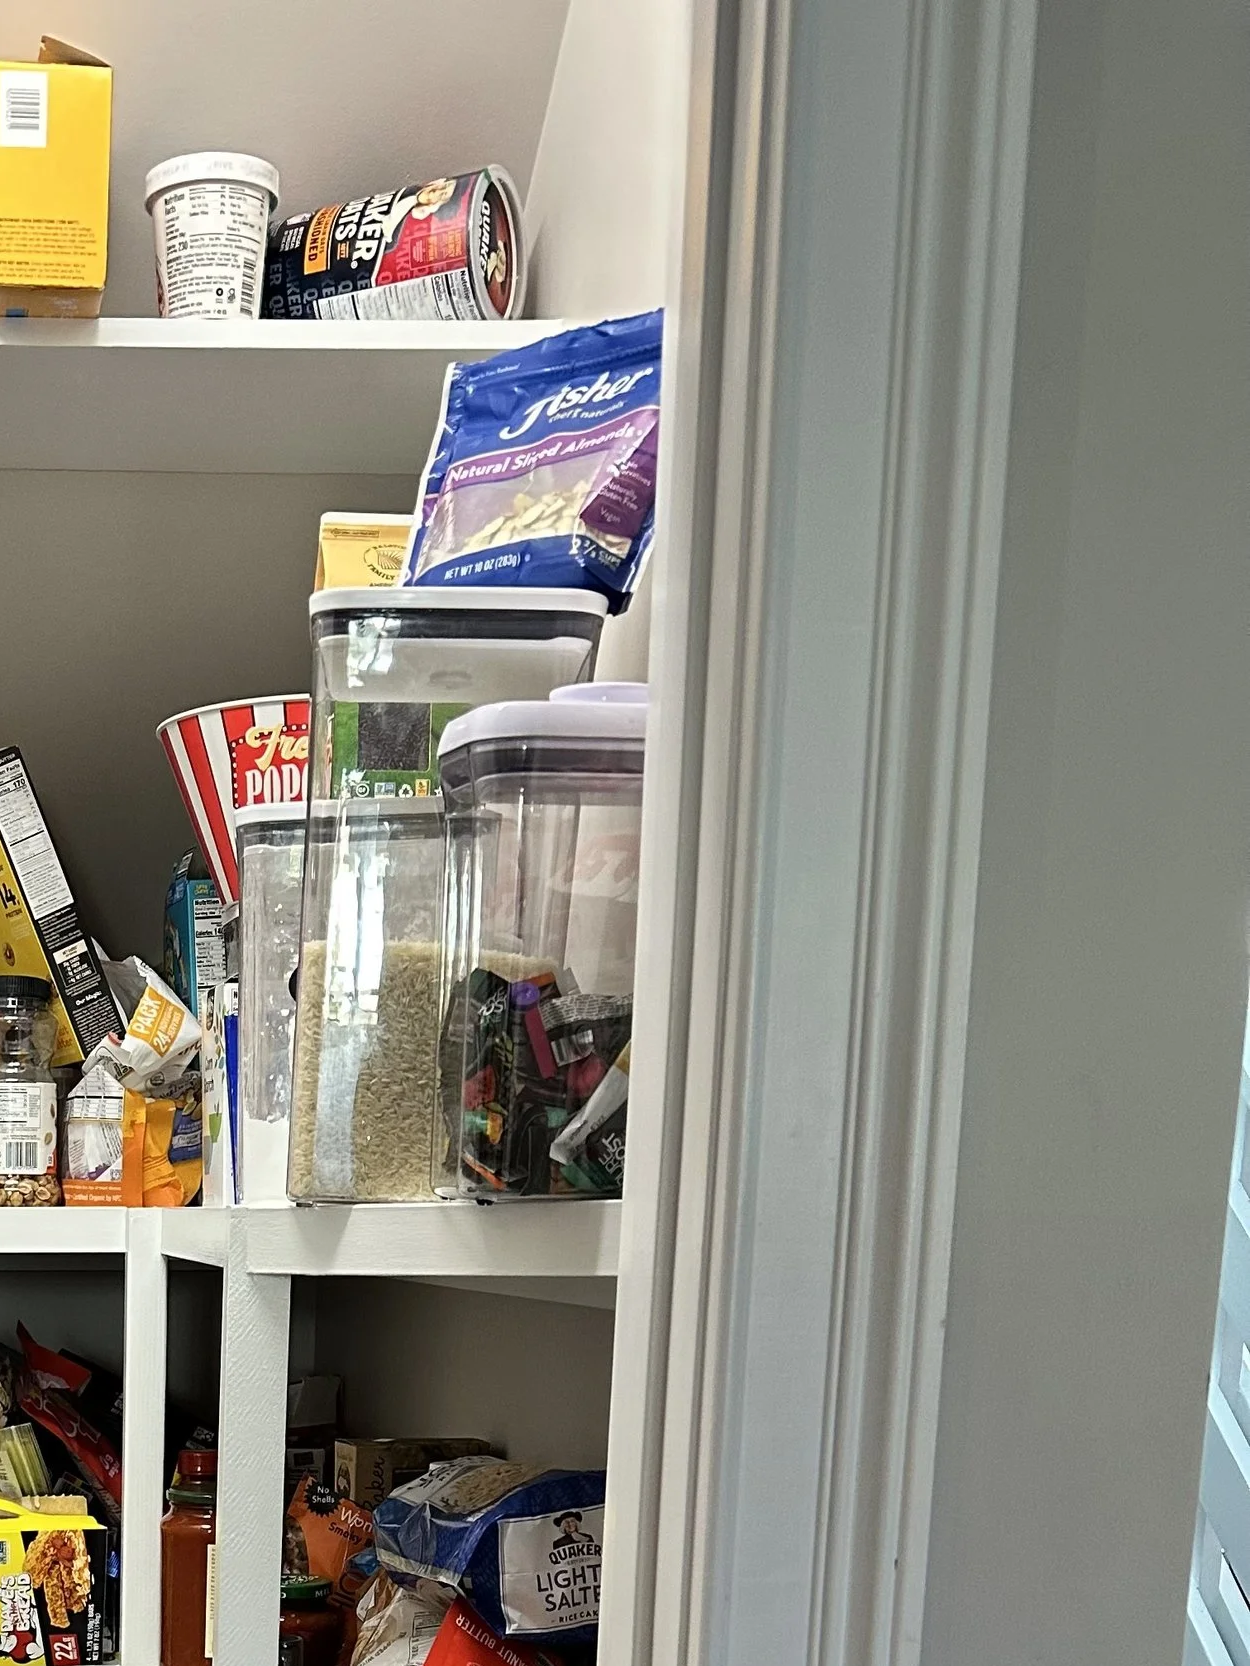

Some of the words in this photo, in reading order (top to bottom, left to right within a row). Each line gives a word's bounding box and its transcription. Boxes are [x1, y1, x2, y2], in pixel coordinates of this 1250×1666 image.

[499, 366, 655, 440] Fisher
[447, 460, 508, 485] Natural
[561, 422, 637, 457] Almonds
[12, 779, 26, 788] 170
[131, 993, 164, 1036] PACK
[152, 1031, 171, 1052] 24
[312, 1494, 336, 1504] Shells
[317, 1485, 330, 1494] No
[548, 1543, 602, 1566] QUAKER
[536, 1563, 602, 1593] LIGHT
[16, 1572, 33, 1631] BREAD
[545, 1584, 601, 1612] SALTE
[559, 1613, 578, 1623] RICE
[579, 1609, 599, 1619] CAK
[454, 1612, 496, 1650] BUTTER
